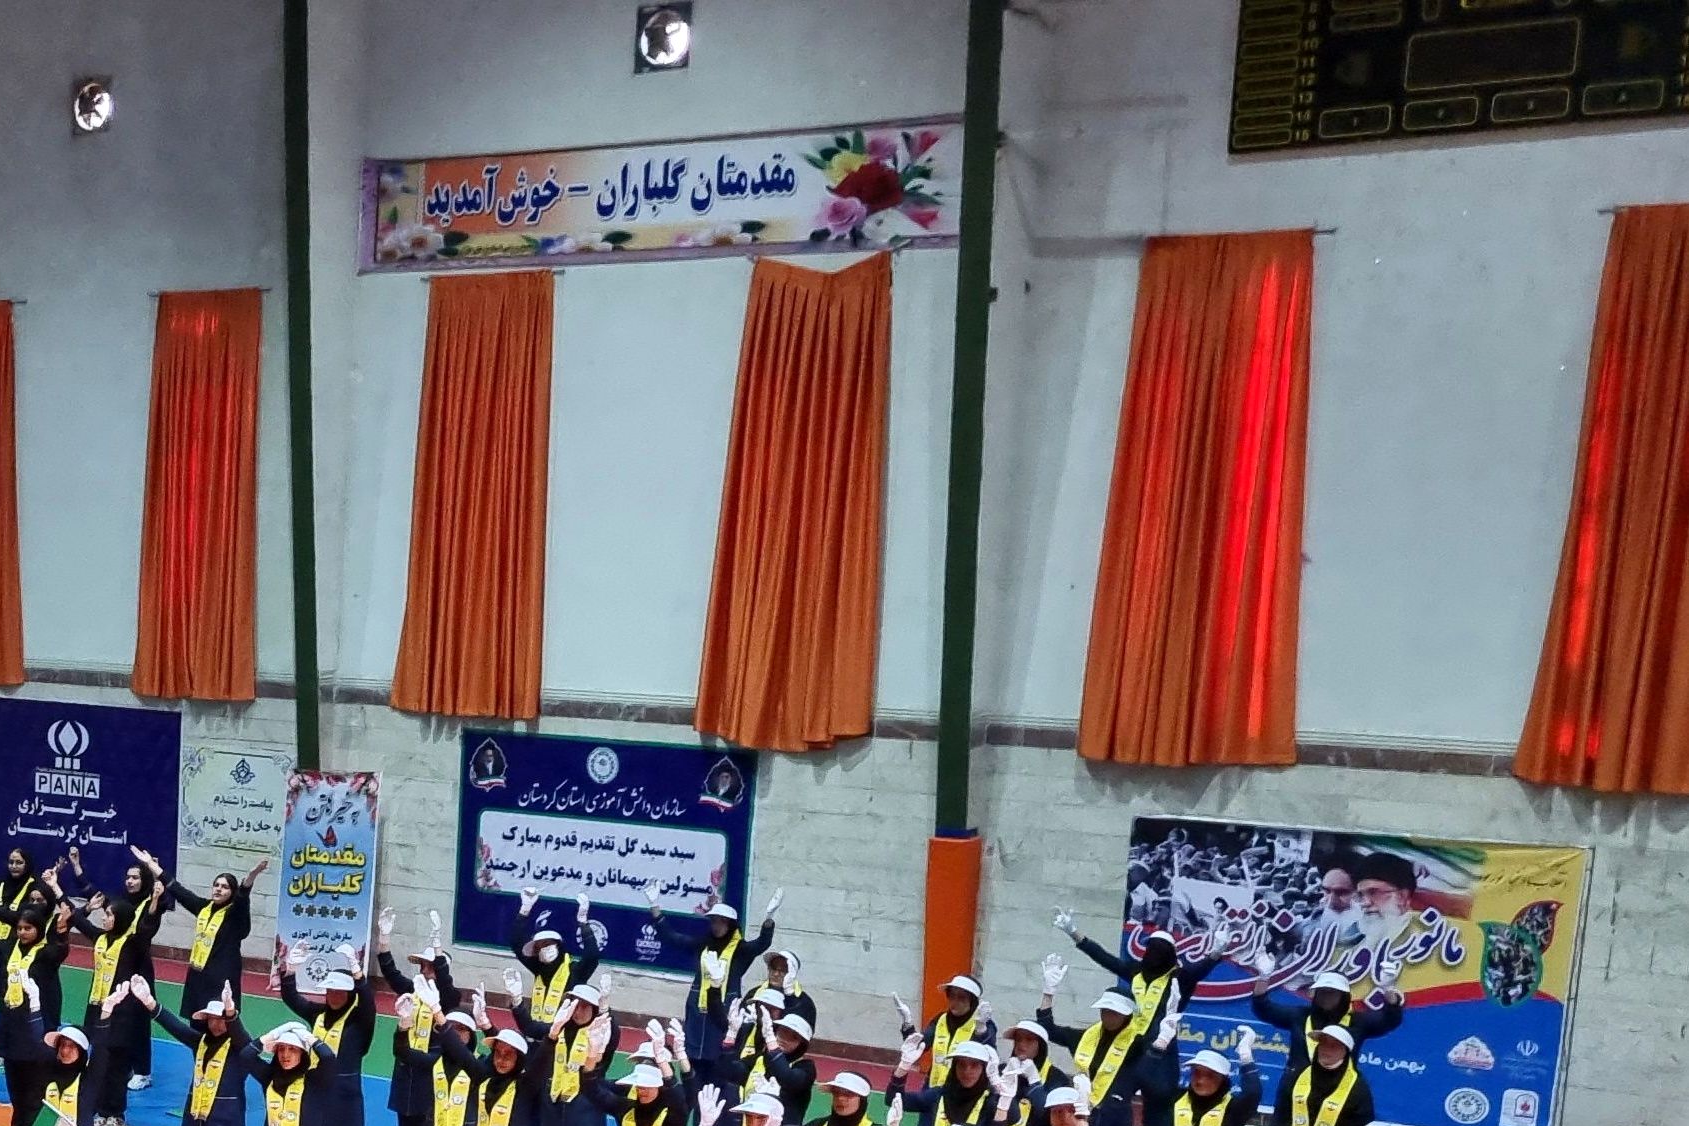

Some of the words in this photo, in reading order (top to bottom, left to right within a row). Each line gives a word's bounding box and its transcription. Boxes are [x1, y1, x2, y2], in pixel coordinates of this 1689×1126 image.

[595, 156, 688, 218] گلباران
[690, 152, 796, 212] مقدمتان
[426, 163, 501, 227] آمدید
[496, 165, 562, 227] خوش
[36, 773, 99, 798] PANA
[518, 779, 569, 810] کردستان
[556, 786, 586, 810] استان
[585, 786, 628, 813] آموزی
[623, 786, 651, 816] دانش
[650, 798, 687, 819] سازمان
[8, 817, 79, 843] کردستان
[79, 826, 128, 845] استان
[230, 817, 244, 831] دل
[502, 825, 542, 848] مبارک
[544, 830, 578, 851] قدوم
[580, 834, 616, 854] تقدیم
[617, 836, 639, 857] گل
[290, 842, 367, 869] مقدمتان
[640, 841, 667, 861] سبد
[669, 845, 696, 864] سبد
[485, 857, 531, 880] ارجمند
[532, 862, 584, 882] مدعوین
[584, 871, 593, 886] و
[287, 871, 365, 900] گلباران
[659, 874, 713, 898] مسئولین
[312, 930, 330, 940] دانش
[1388, 906, 1466, 966] مانور
[1358, 1051, 1382, 1065] ماه
[1384, 1058, 1427, 1075] بهمن
